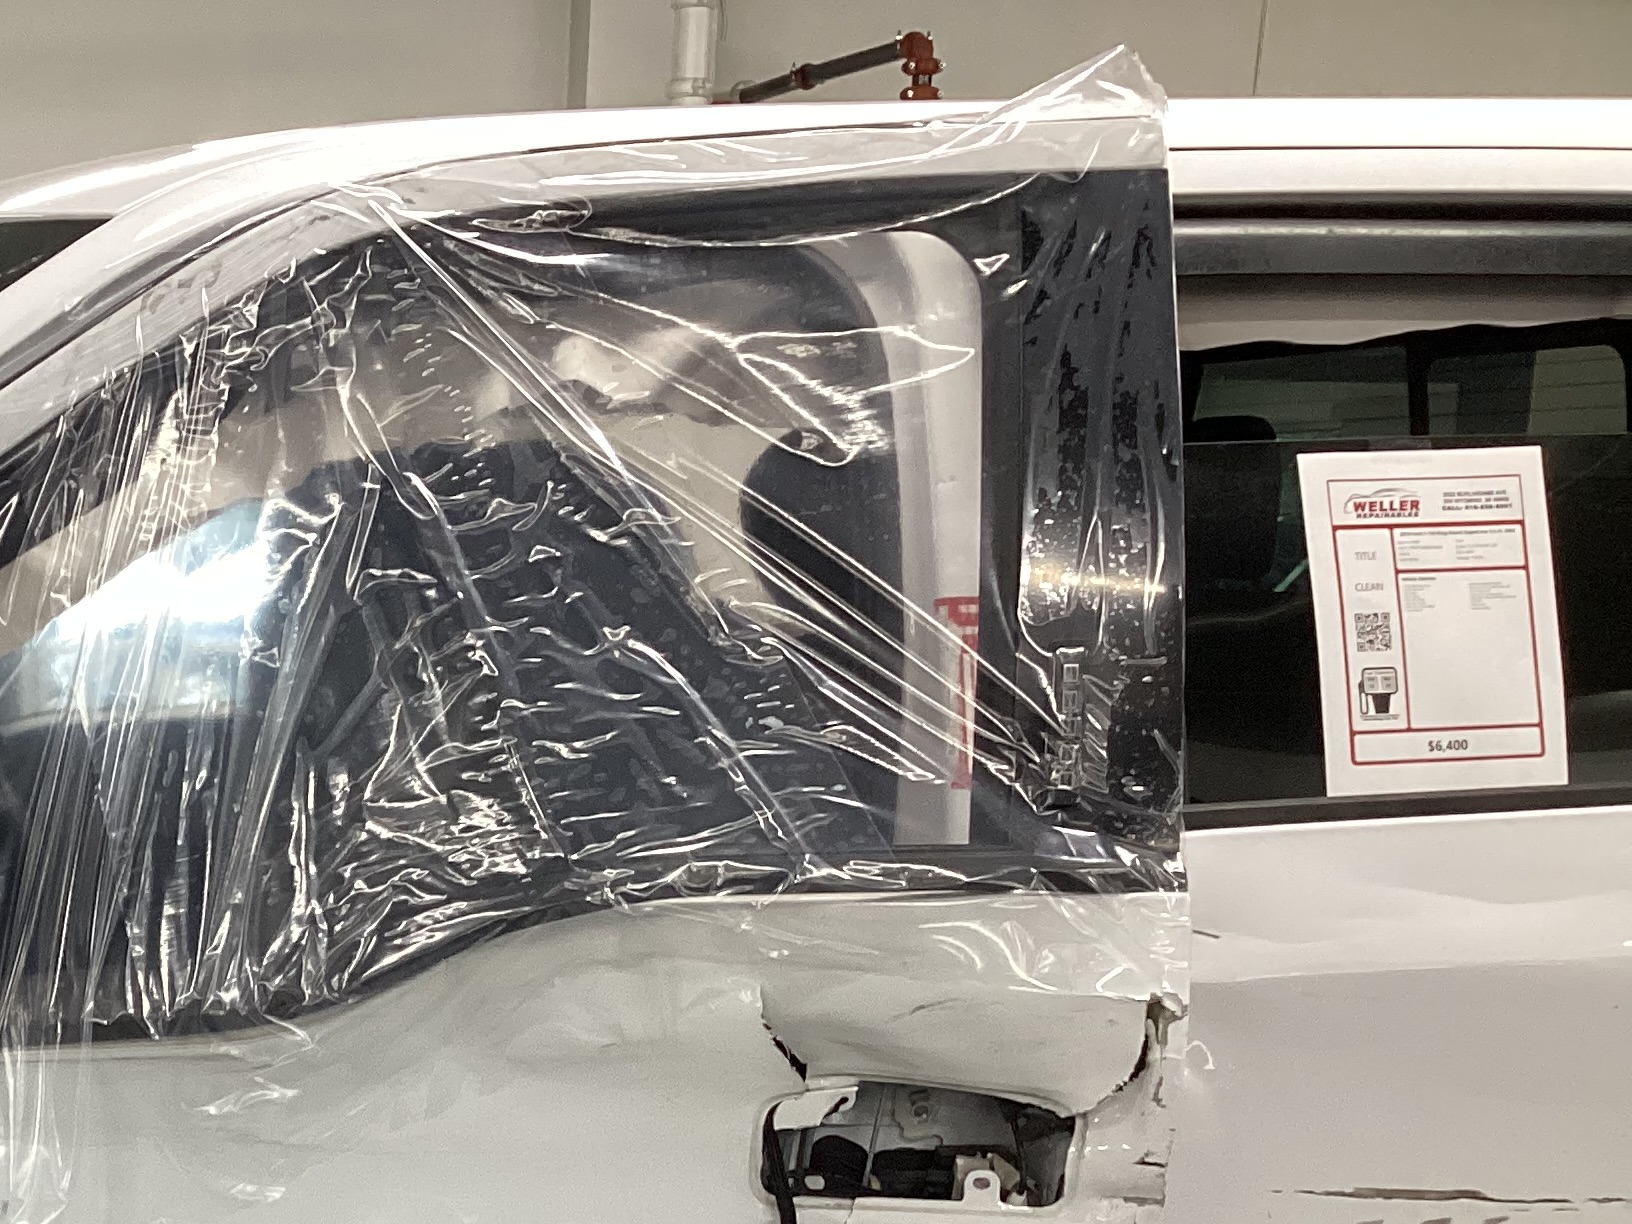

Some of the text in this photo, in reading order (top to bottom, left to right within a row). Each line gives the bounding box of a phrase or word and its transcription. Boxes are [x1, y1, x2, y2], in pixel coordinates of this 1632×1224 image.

[1353, 500, 1421, 512] WELLER
[1355, 551, 1377, 560] TITLE
[1355, 582, 1384, 592] CLEAN
[1428, 739, 1469, 753] $6,400
